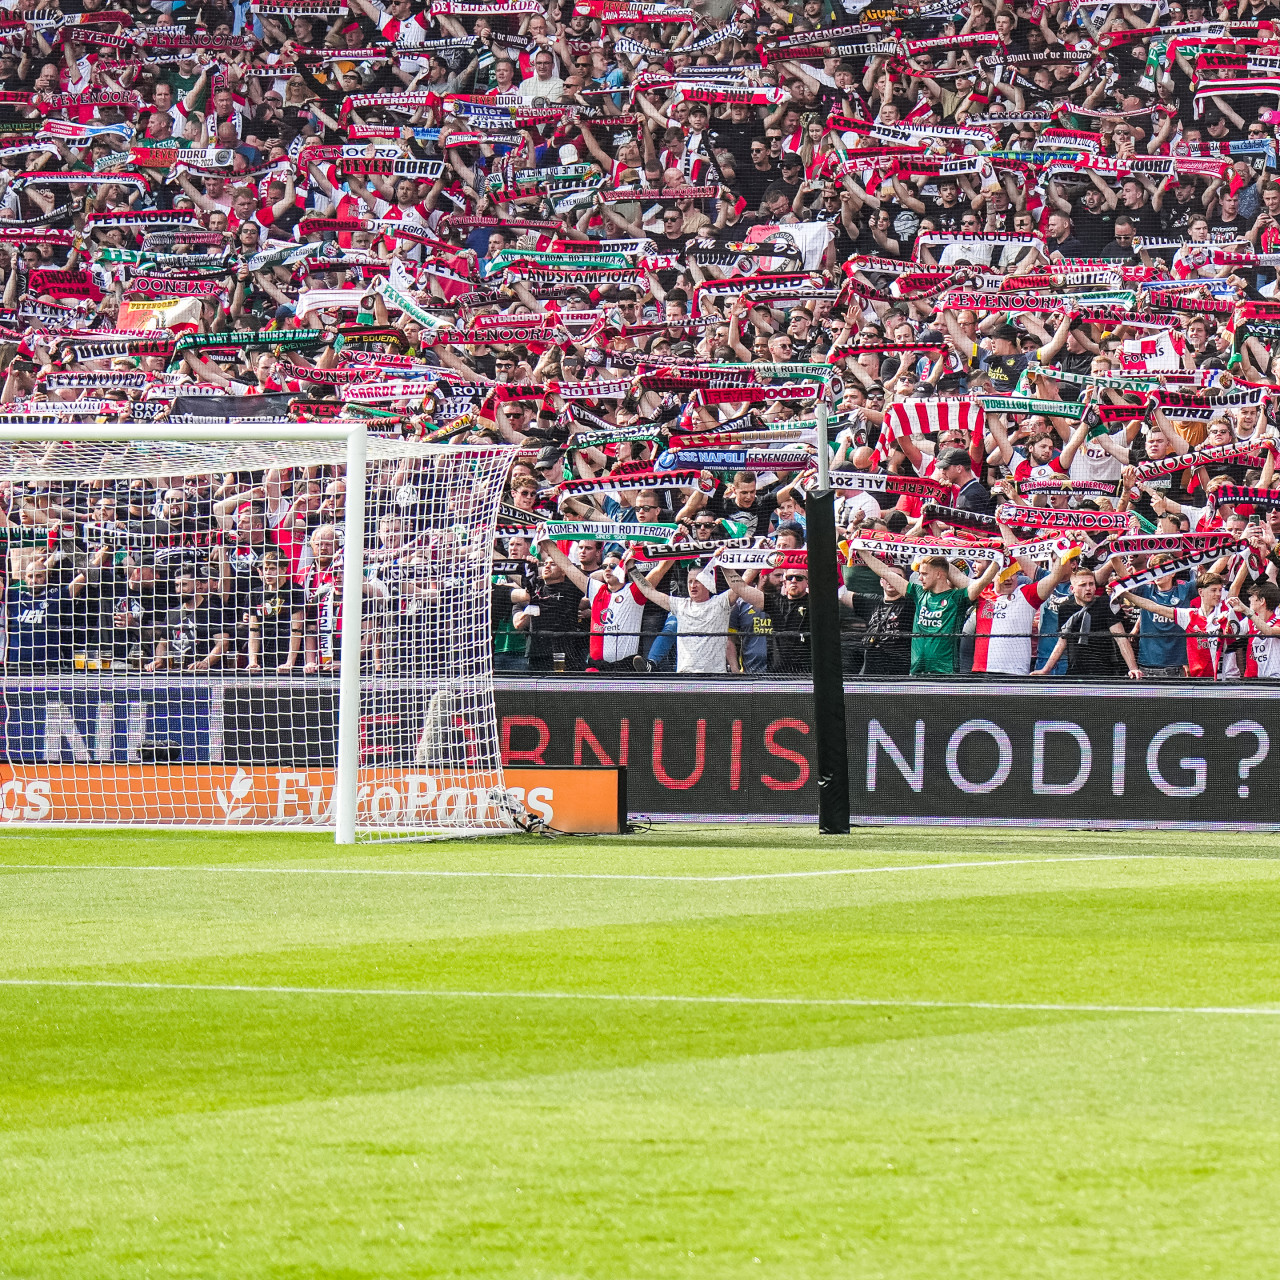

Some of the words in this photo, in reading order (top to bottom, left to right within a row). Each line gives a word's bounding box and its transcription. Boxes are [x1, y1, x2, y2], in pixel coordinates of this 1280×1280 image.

[432, 1, 447, 13] DE
[838, 43, 898, 54] ROTTERDAM
[910, 35, 1000, 49] LANDSKAMPIOEN
[985, 55, 1003, 66] We
[1006, 54, 1029, 65] shall
[1031, 53, 1044, 64] not
[1059, 51, 1093, 62] moved
[351, 96, 428, 107] ROTTERDAM
[688, 91, 716, 103] SLOT
[720, 91, 754, 104] ARNE
[470, 105, 502, 117] Inter
[93, 213, 192, 225] FEYENOORD
[501, 253, 520, 263] WE
[523, 253, 541, 263] ARE
[544, 253, 566, 264] FROM
[569, 254, 626, 267] ROTTERDAM
[438, 329, 553, 344] FEYENOORD
[678, 452, 697, 463] SSC
[699, 452, 743, 463] NAPOLI
[746, 452, 810, 463] FEYENOORD
[549, 524, 577, 535] KOMEN
[580, 524, 597, 535] WIJ
[600, 524, 614, 535] UIT
[617, 524, 676, 537] ROTTERDAM
[648, 538, 751, 557] FEYENOORD
[861, 540, 942, 556] KAMPIOEN
[946, 547, 997, 559] 2023
[920, 606, 943, 618] Euro
[918, 617, 944, 629] Parcs
[867, 717, 1270, 799] NODIG?
[275, 773, 553, 830] EuroParcs
